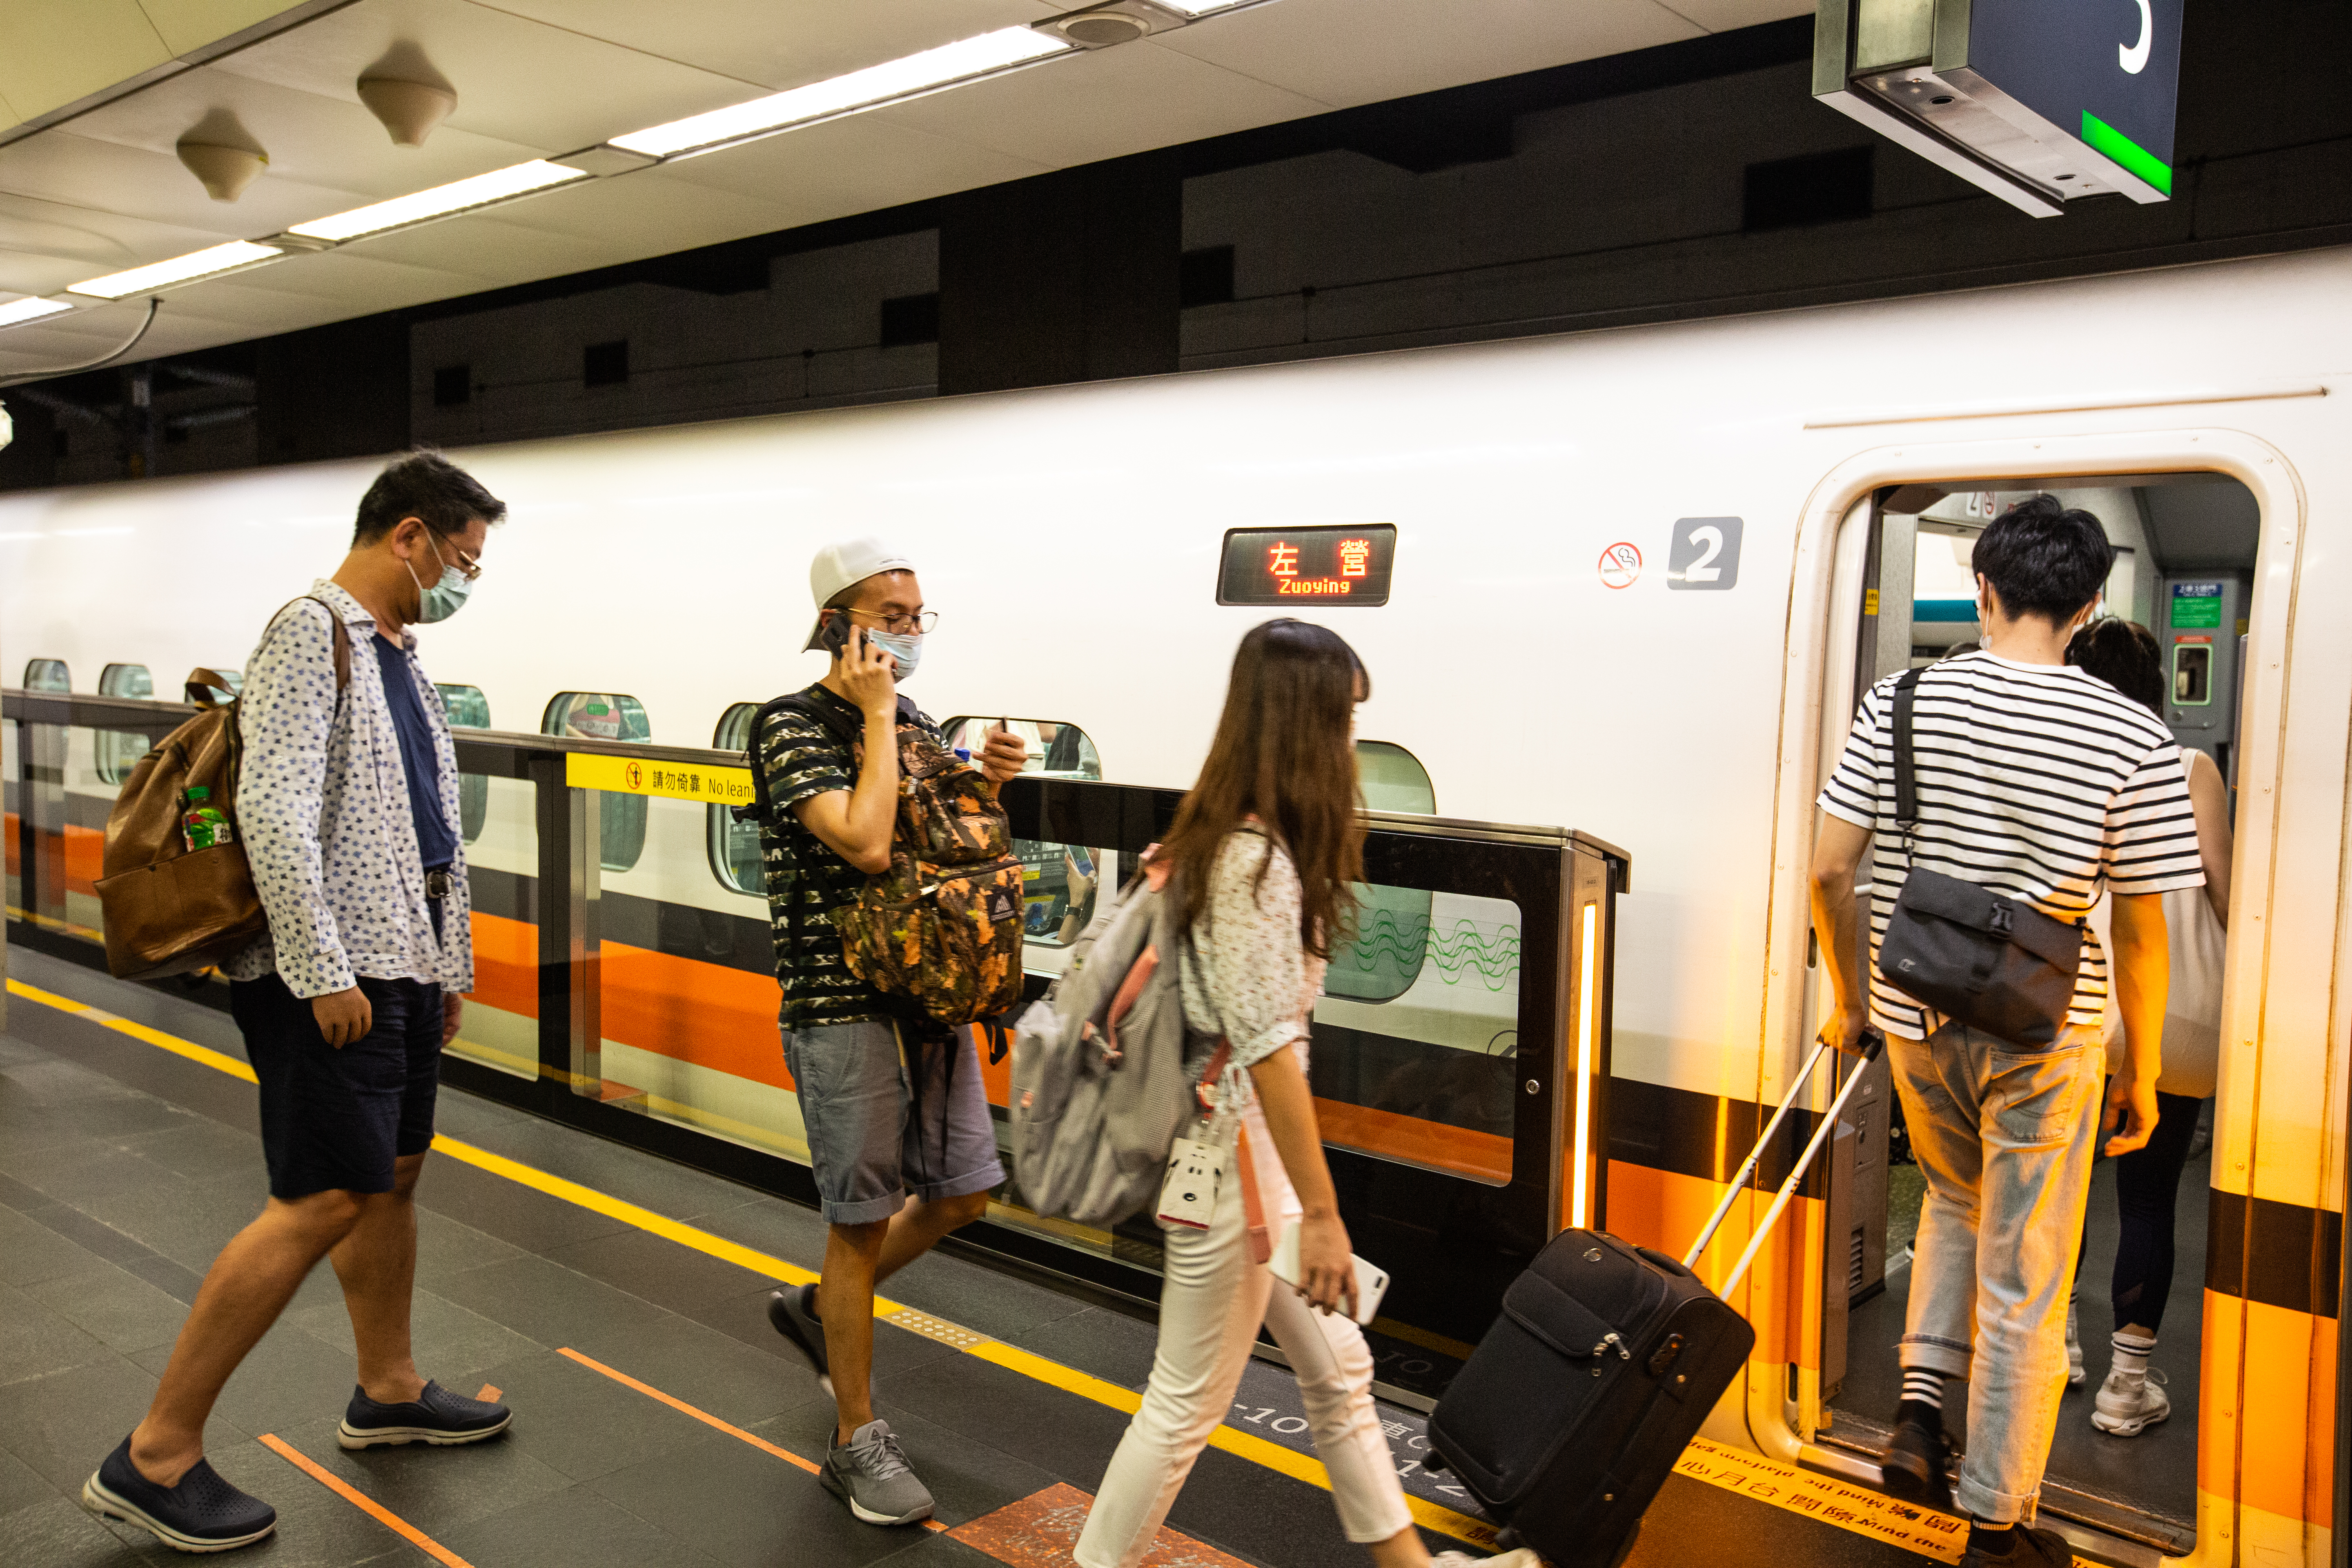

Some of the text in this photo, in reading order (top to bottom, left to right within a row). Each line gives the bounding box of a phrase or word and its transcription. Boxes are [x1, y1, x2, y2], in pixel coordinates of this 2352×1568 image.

[1269, 540, 1370, 576] 左營
[1685, 525, 1723, 581] 2
[1279, 578, 1350, 594] Zuoying
[653, 770, 754, 799] 請勿倚靠 No leani
[1234, 1403, 1309, 1433] -10
[1719, 1452, 1795, 1477] platform
[1804, 1479, 1833, 1491] the
[1837, 1489, 1884, 1509] Mind
[1856, 1518, 1910, 1539] Mind
[1914, 1537, 1947, 1551] the
